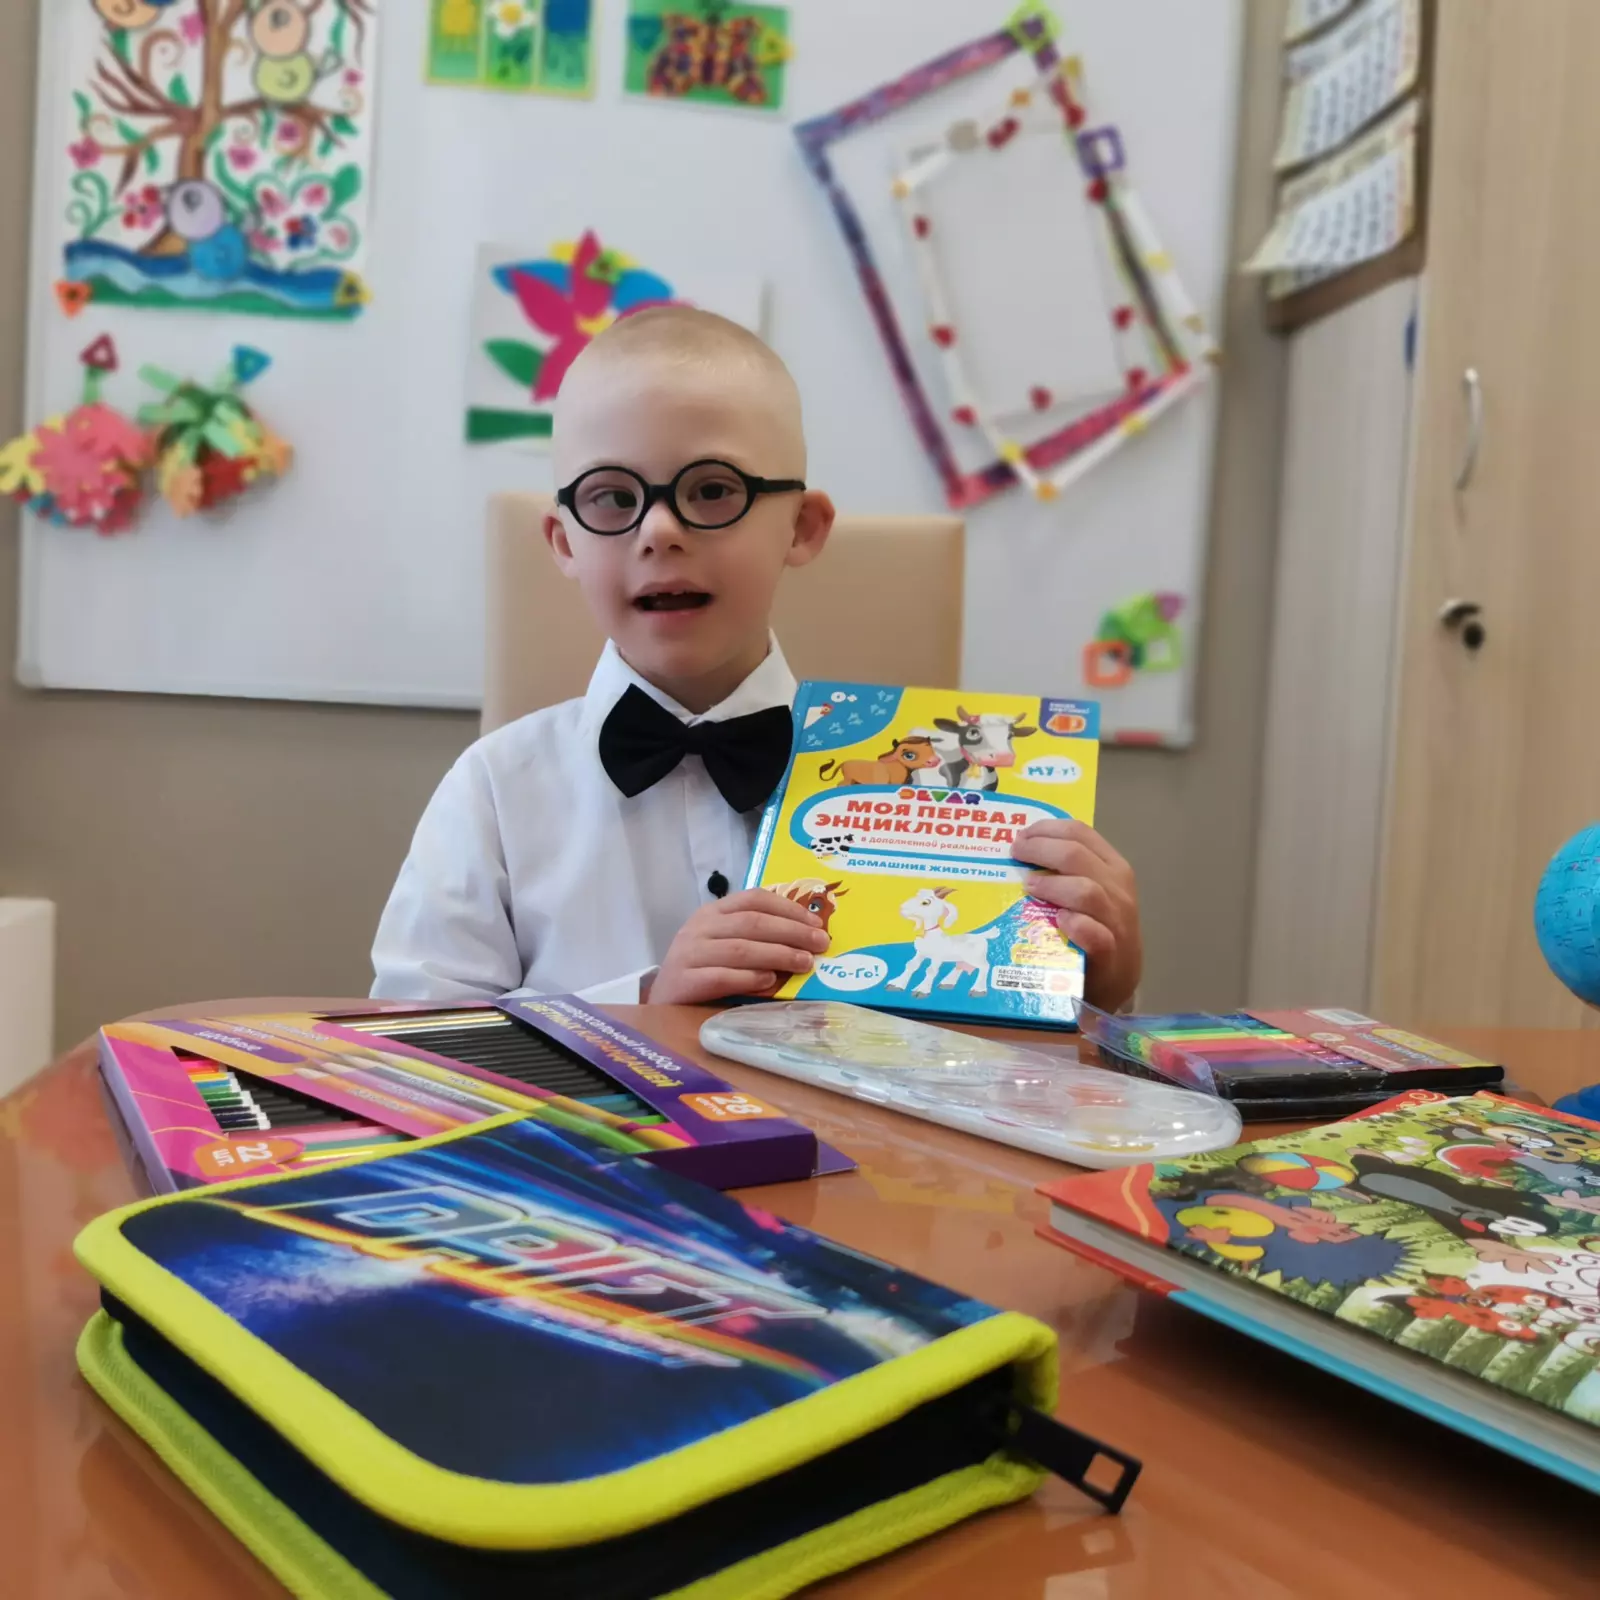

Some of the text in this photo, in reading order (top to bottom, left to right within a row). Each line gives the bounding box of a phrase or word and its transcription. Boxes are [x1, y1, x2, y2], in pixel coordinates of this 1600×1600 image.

[847, 800, 1027, 825] МОЯ ПЕРВАЯ
[869, 837, 938, 848] дополненной
[940, 841, 1001, 853] реальности
[847, 859, 1007, 878] ДОМАШНИЕ ЖИВОТНЫЕ
[711, 1096, 763, 1114] 28
[236, 1142, 273, 1163] 22
